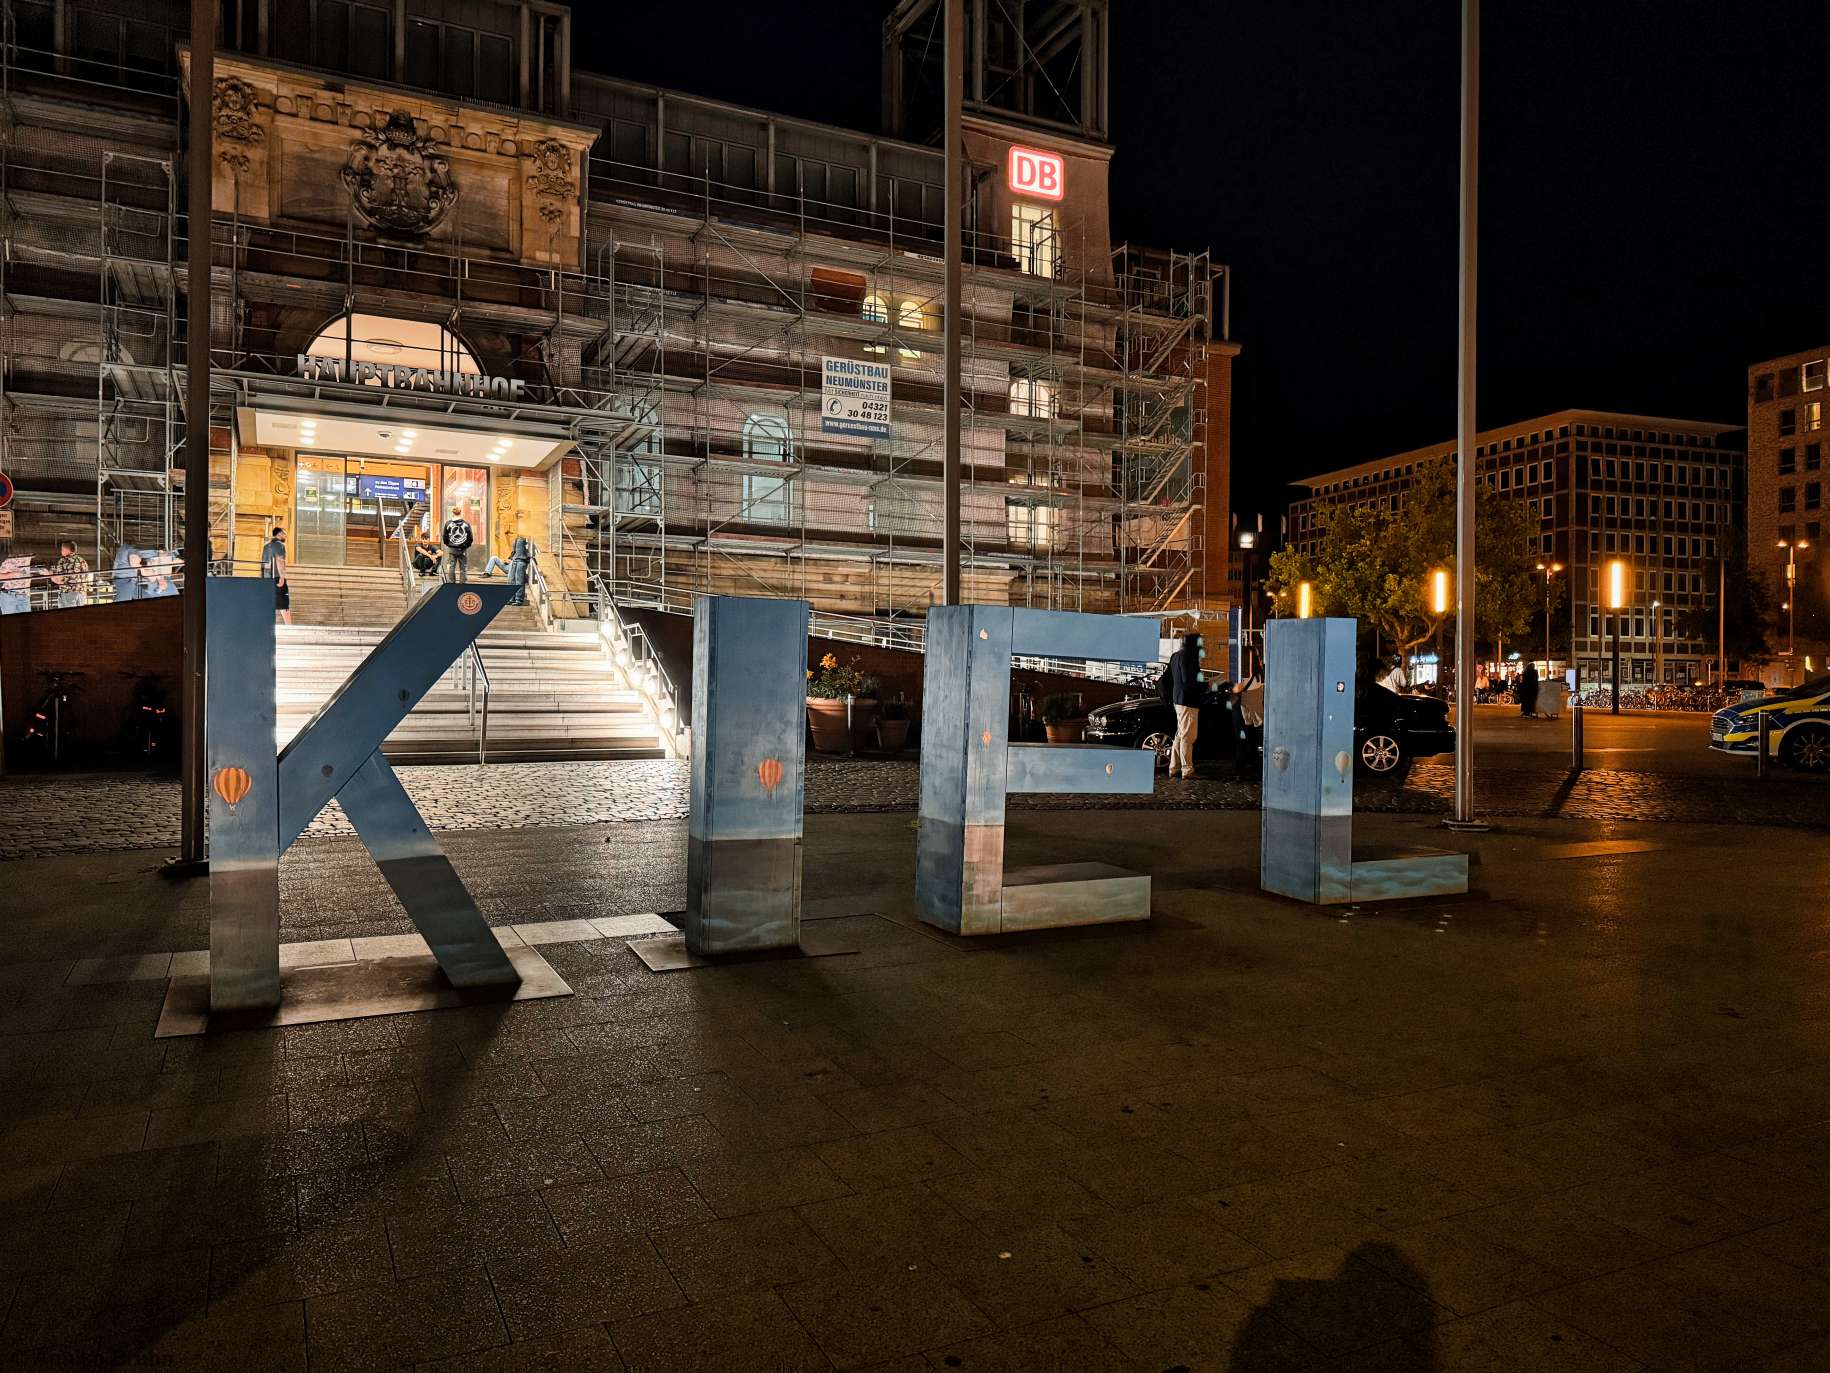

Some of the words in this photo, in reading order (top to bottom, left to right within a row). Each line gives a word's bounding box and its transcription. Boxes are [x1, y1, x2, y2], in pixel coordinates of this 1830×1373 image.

[1017, 155, 1057, 191] DB
[297, 353, 526, 401] HAUPTBAHNHOF
[826, 360, 888, 379] GERÜSTBAU
[826, 375, 888, 393] NEUMÜNSTER
[847, 410, 859, 418] 30
[860, 411, 872, 420] 48
[873, 413, 888, 422] 123
[862, 401, 888, 412] 04321
[205, 576, 1469, 1010] KIEL
